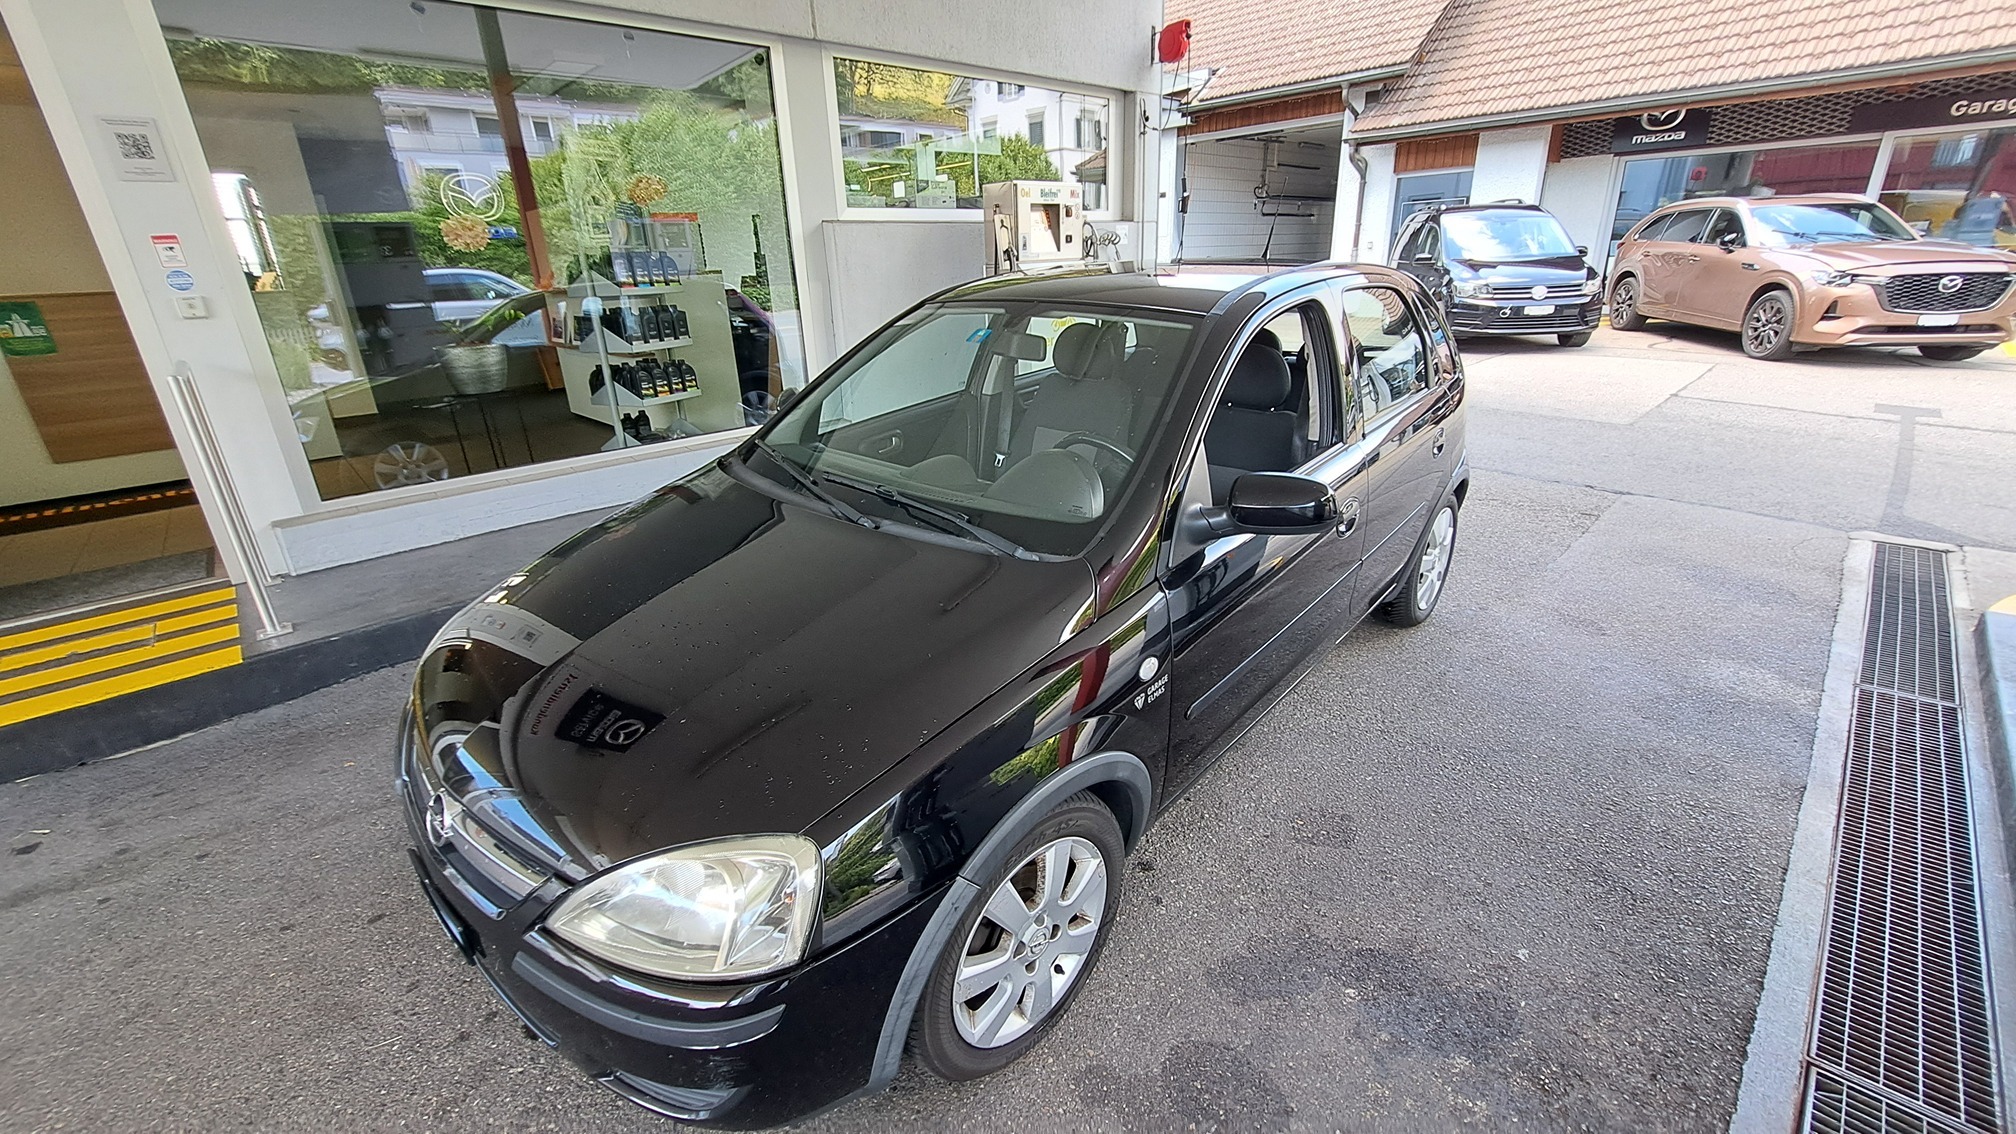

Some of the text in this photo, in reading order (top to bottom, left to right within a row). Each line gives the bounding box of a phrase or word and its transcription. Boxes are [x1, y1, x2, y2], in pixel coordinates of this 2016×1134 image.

[1020, 188, 1031, 198] Oel
[1069, 189, 1080, 199] Mix
[1147, 674, 1168, 695] GARAGE
[1147, 685, 1165, 703] ELMAS
